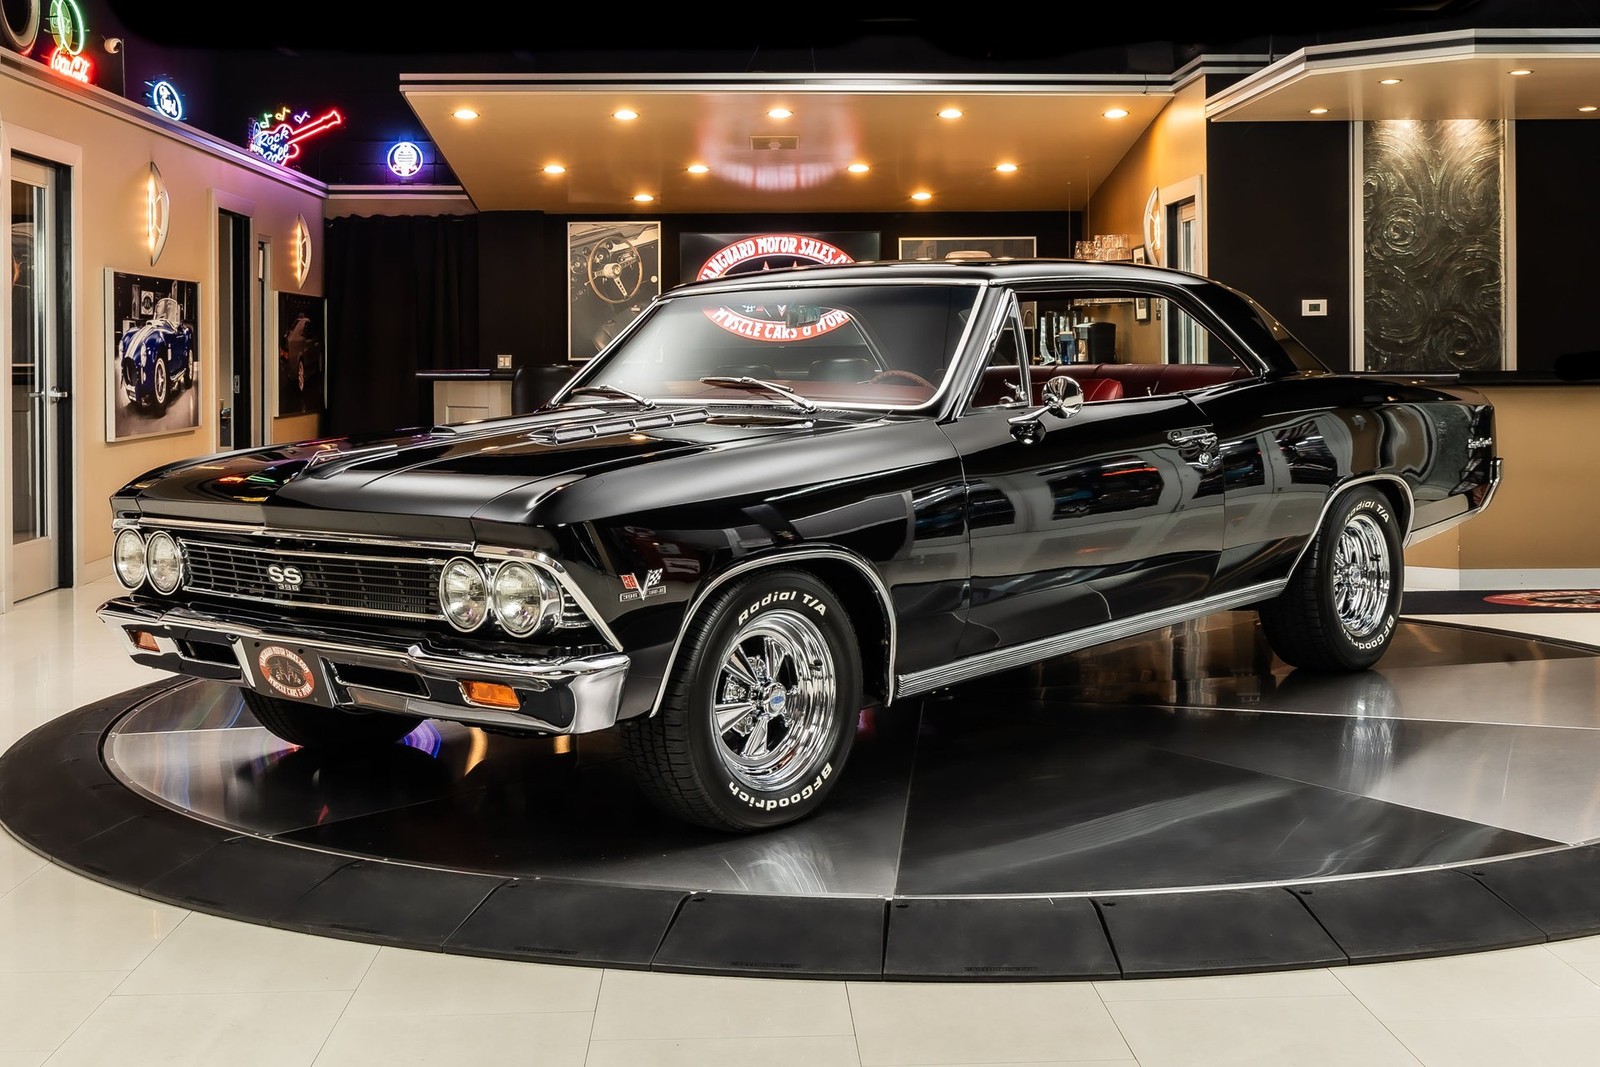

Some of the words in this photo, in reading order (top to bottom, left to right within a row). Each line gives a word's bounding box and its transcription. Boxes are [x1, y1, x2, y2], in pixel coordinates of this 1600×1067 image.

[259, 126, 289, 147] Rock
[756, 236, 798, 255] MOTOR
[711, 307, 761, 338] MUSCLE
[764, 323, 798, 339] CARS
[1376, 504, 1390, 523] T/A
[268, 566, 301, 584] SS
[278, 583, 299, 591] 396
[738, 590, 797, 626] Radial
[802, 593, 827, 616] T/A
[728, 762, 833, 811] BFGoodrich
